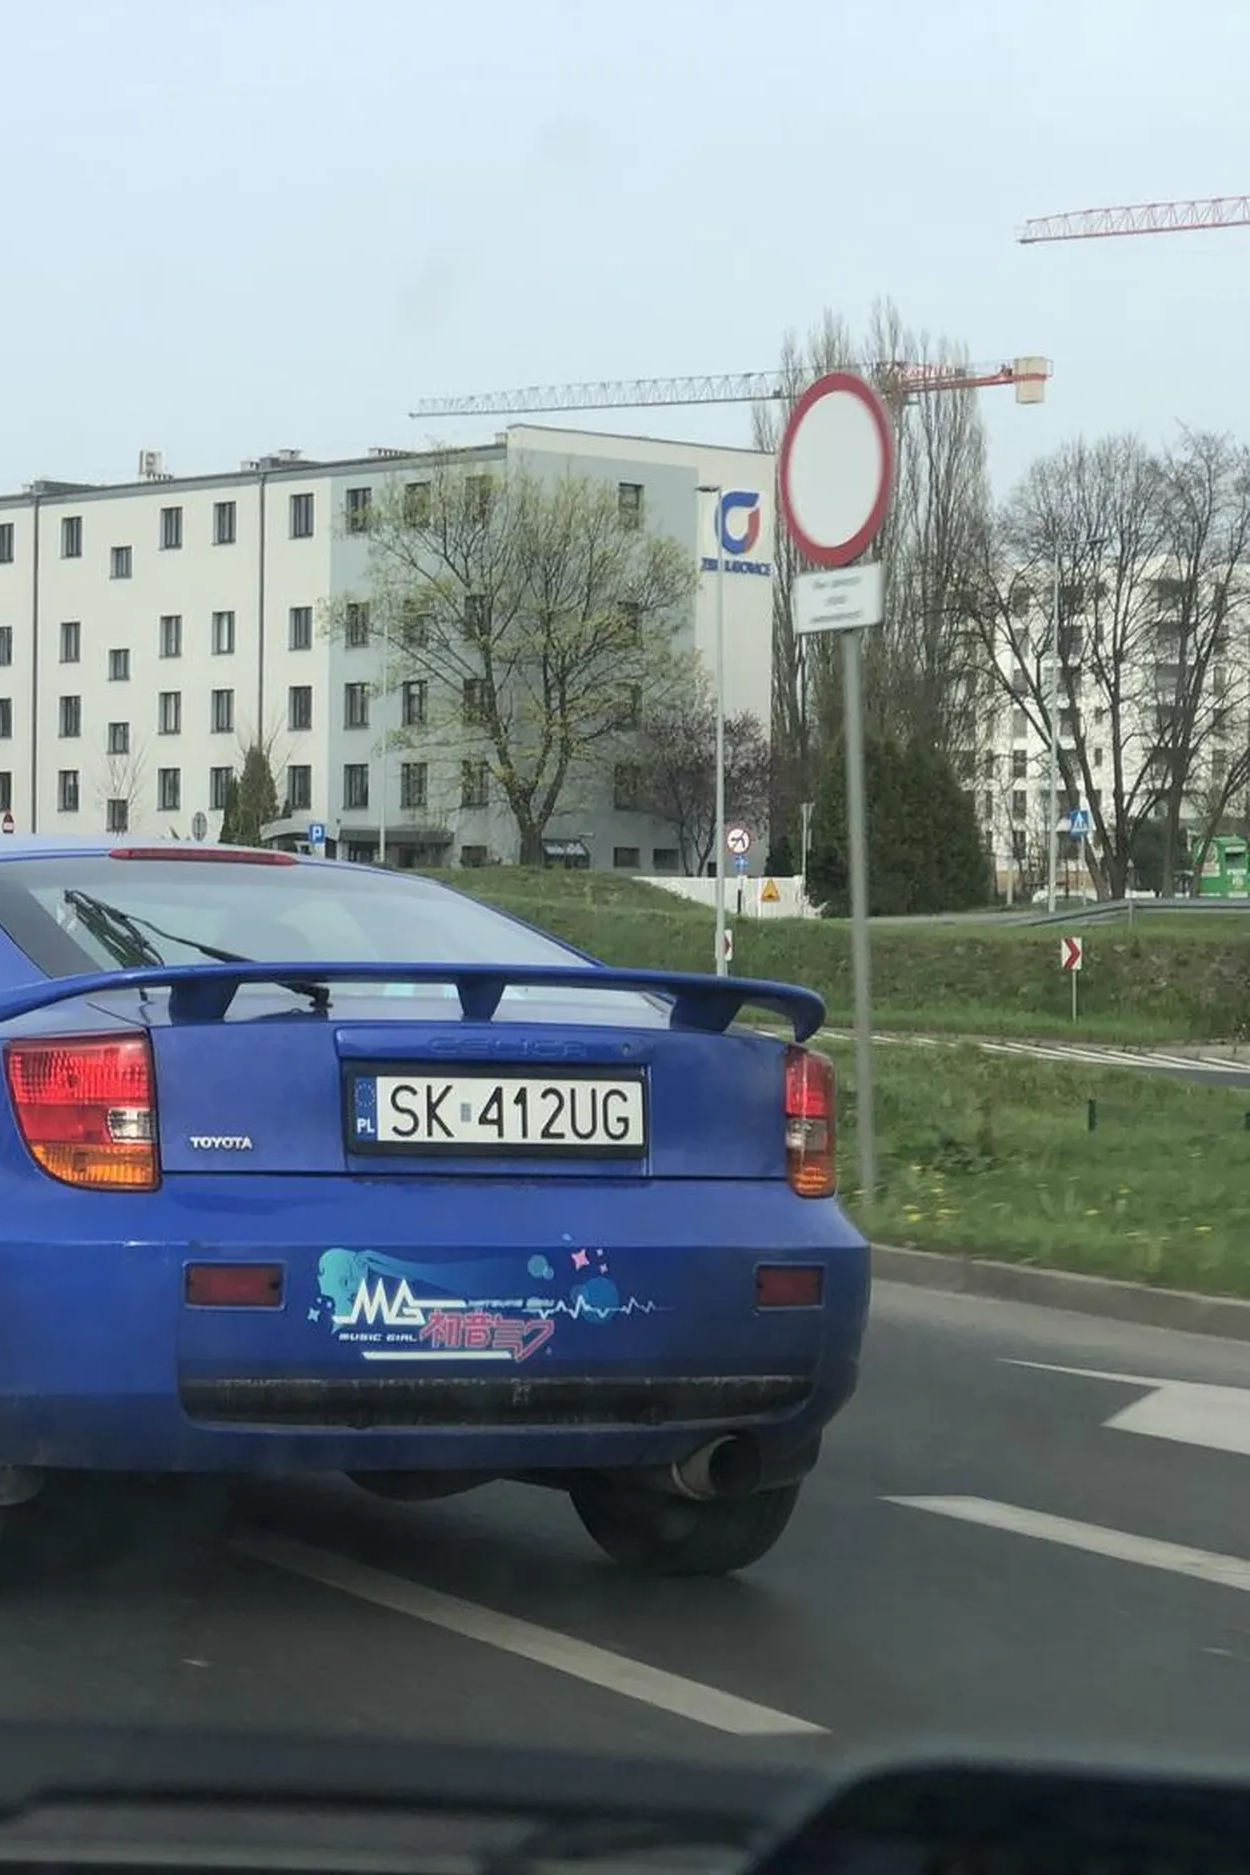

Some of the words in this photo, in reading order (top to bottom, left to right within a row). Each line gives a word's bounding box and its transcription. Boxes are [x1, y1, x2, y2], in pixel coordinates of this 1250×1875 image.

[390, 1084, 455, 1138] SK
[478, 1086, 630, 1141] 412UG
[357, 1118, 375, 1133] PL
[190, 1136, 252, 1149] TOYOTA
[338, 1332, 382, 1342] MUSIC
[387, 1333, 419, 1343] GIRL
